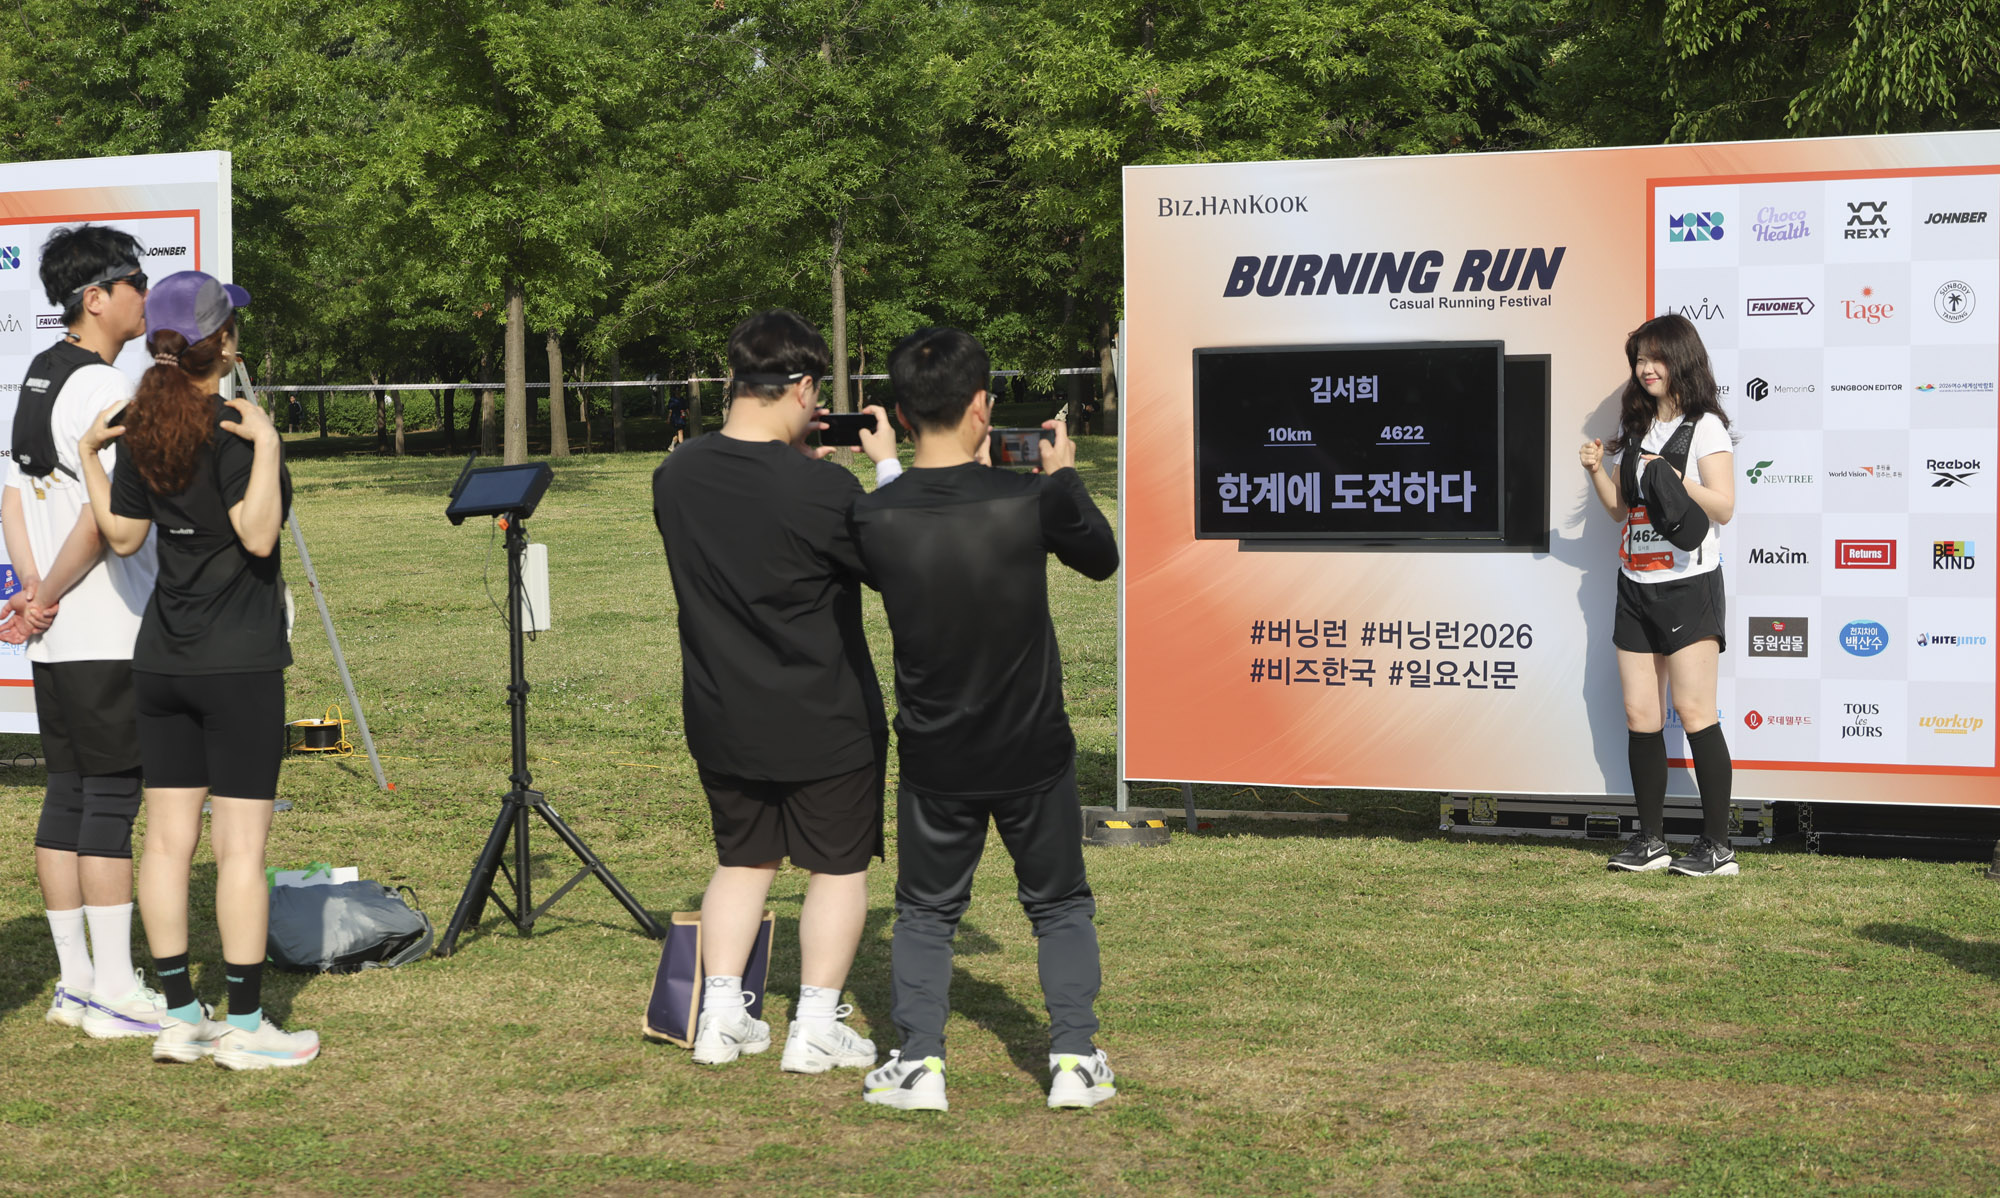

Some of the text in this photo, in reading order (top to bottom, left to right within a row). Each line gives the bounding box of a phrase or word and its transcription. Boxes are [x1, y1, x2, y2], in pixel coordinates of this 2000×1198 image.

[1757, 206, 1807, 224] Choco
[1924, 211, 1988, 225] JOHNBER
[1752, 220, 1811, 242] Health
[1844, 228, 1891, 240] REXY
[146, 246, 187, 257] JOHNBER
[1222, 246, 1567, 298] BURNING RUN
[1940, 282, 1971, 296] SUNBODY
[1389, 294, 1552, 311] Casual Running Festival
[1752, 301, 1804, 312] FAVONEX
[1841, 300, 1894, 325] Tage
[1942, 311, 1968, 321] TANNING
[1309, 374, 1379, 404] 김서희
[1774, 384, 1815, 393] MemorinG
[1267, 427, 1312, 443] 10km
[1380, 425, 1425, 441] 4622
[1926, 459, 1981, 470] Reebok
[1763, 475, 1814, 484] NEWTREE
[1217, 470, 1477, 514] 한계에 도전하다
[1849, 548, 1882, 560] Returns
[1933, 556, 1975, 569] KIND
[1250, 618, 1534, 650] #버닝런 #버닝런2026
[1850, 627, 1878, 636] 천지차이
[1752, 635, 1804, 652] 동원샘물
[1845, 635, 1883, 651] 백산수
[1250, 656, 1519, 690] #비즈한국 #일요신문
[1843, 703, 1880, 715] TOUS
[1767, 715, 1813, 726] 롯데웰푸드
[1855, 714, 1868, 726] les
[1841, 725, 1883, 739] JOURS
